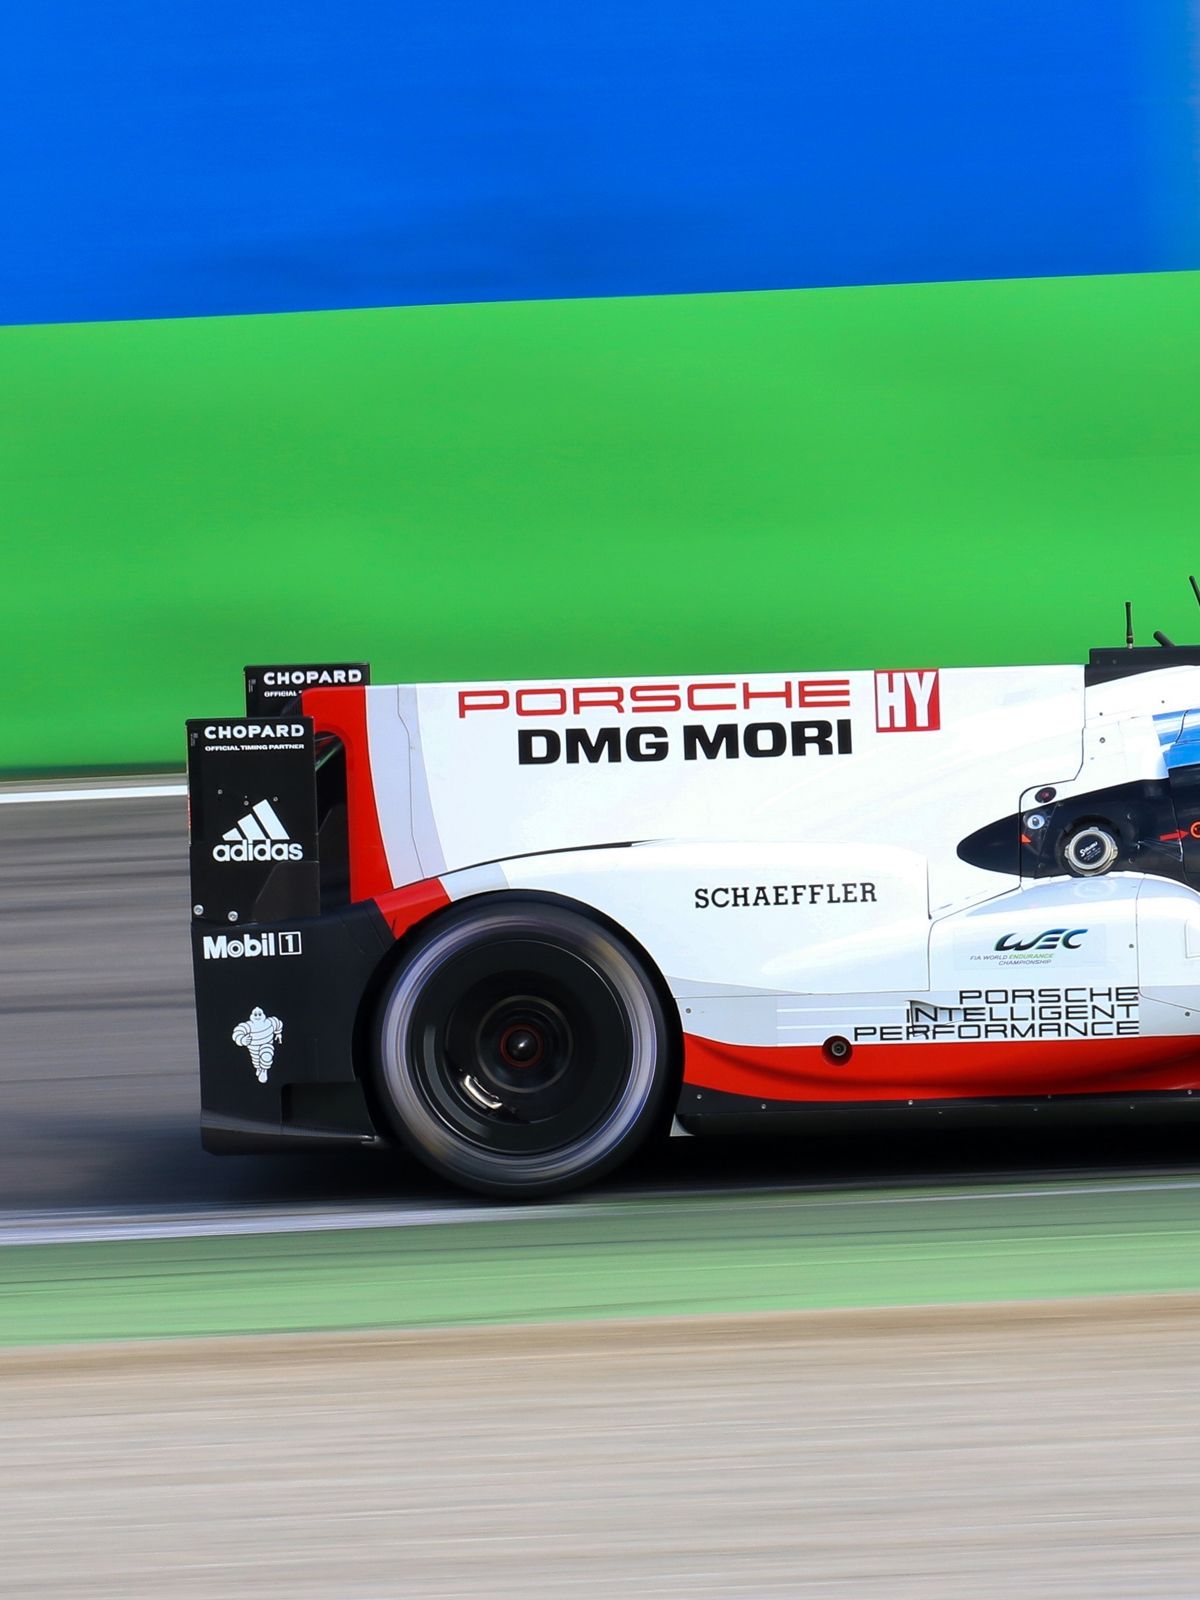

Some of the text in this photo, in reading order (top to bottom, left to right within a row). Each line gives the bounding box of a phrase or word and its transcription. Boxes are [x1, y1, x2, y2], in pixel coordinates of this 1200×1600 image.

[263, 669, 362, 685] CHOPARD
[263, 690, 298, 698] OFFICIAL
[458, 680, 850, 718] PORSCHE
[875, 671, 939, 729] HY
[204, 724, 305, 740] CHOPARD
[518, 719, 853, 765] DMG MORI
[268, 743, 305, 751] PARTNER
[212, 839, 304, 862] adidas
[694, 882, 877, 908] SCHAEFFLER
[203, 932, 275, 959] Mobil
[994, 928, 1089, 951] WEC
[959, 987, 1140, 1004] PORSCHE
[906, 1004, 1140, 1023] INTELLIGENT
[853, 1021, 1140, 1041] PERFORMANCE
